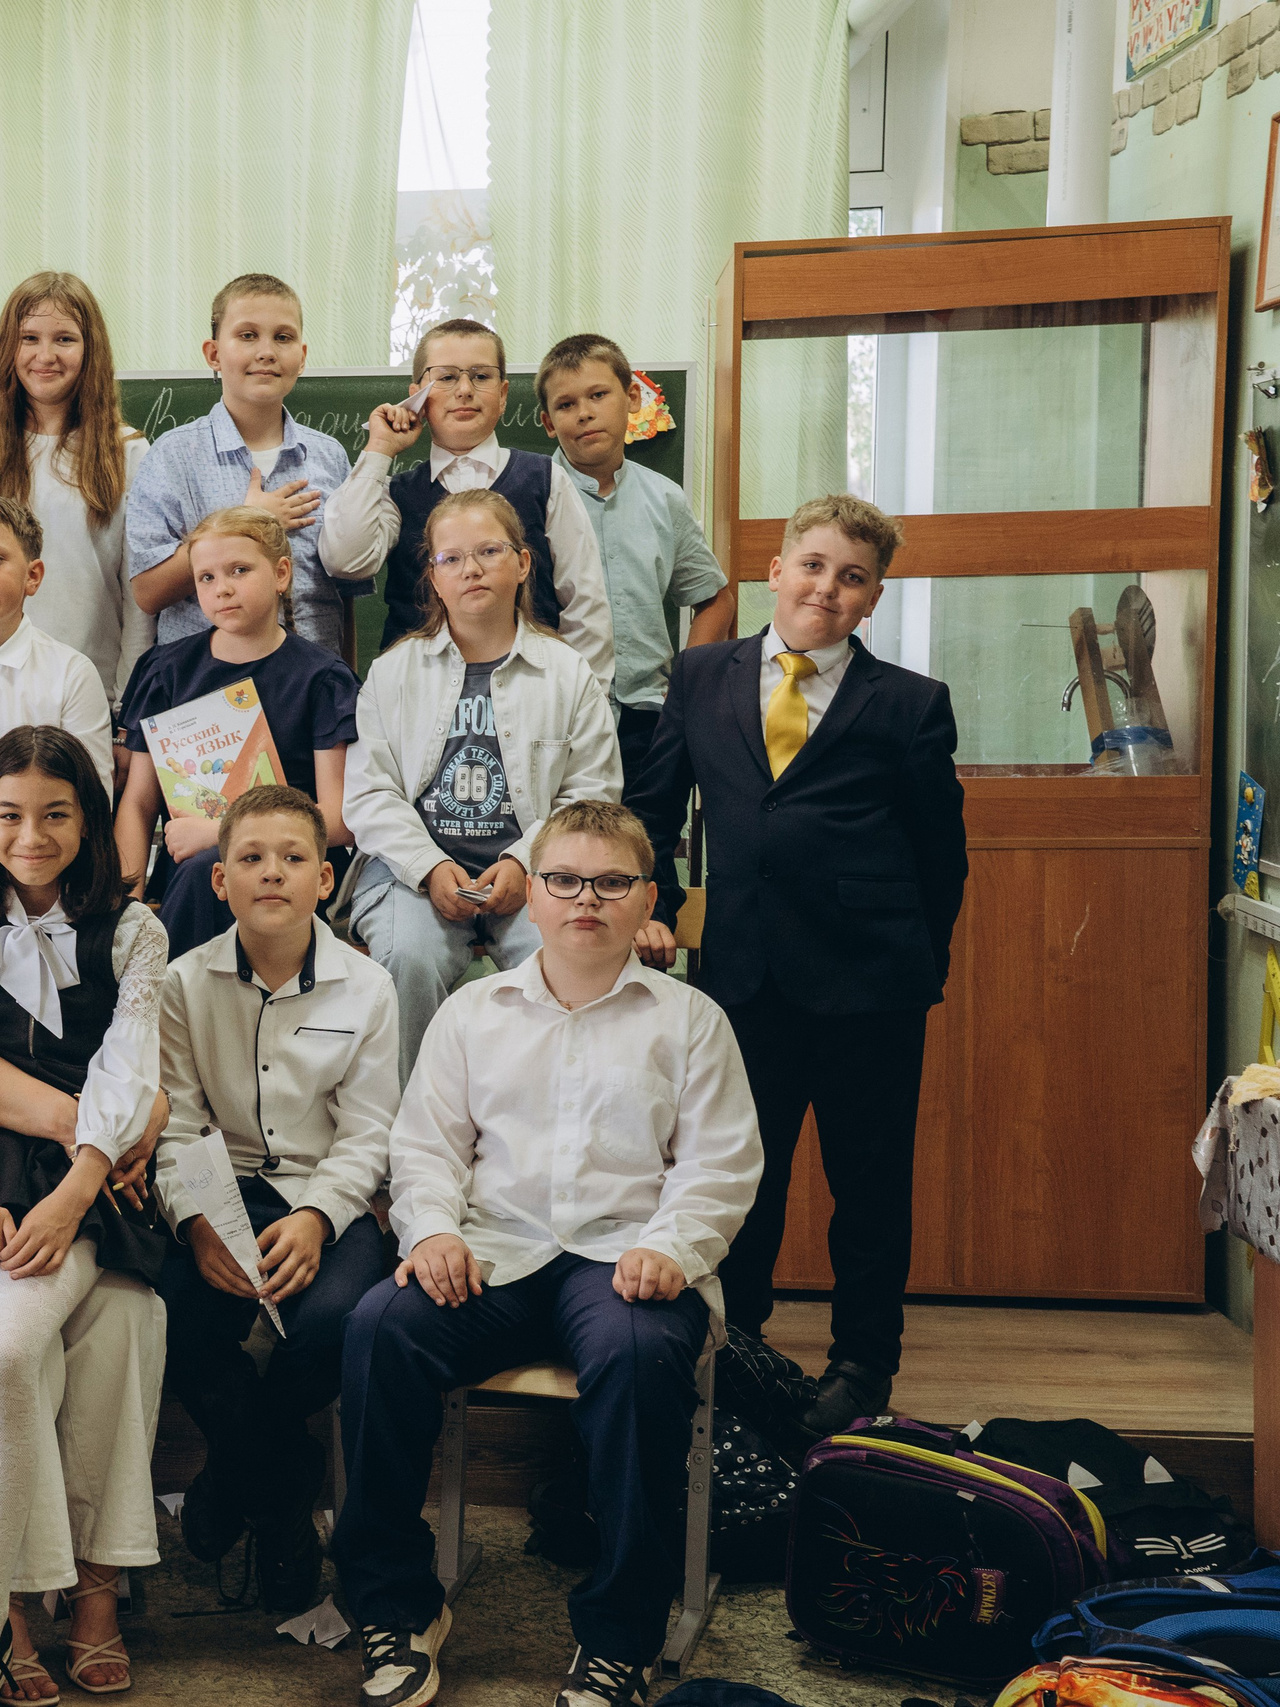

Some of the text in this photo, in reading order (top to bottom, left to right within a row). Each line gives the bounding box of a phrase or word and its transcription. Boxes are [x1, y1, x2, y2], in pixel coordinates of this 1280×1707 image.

[158, 723, 221, 755] Русский
[440, 748, 503, 817] DREAM TEAM COLLEGE LEAGUE
[454, 764, 487, 801] 86
[440, 820, 461, 828] EVER
[464, 820, 474, 828] OR
[478, 821, 504, 829] NEVER
[444, 828, 462, 836] GIRL
[977, 1572, 996, 1624] SKYNAME
